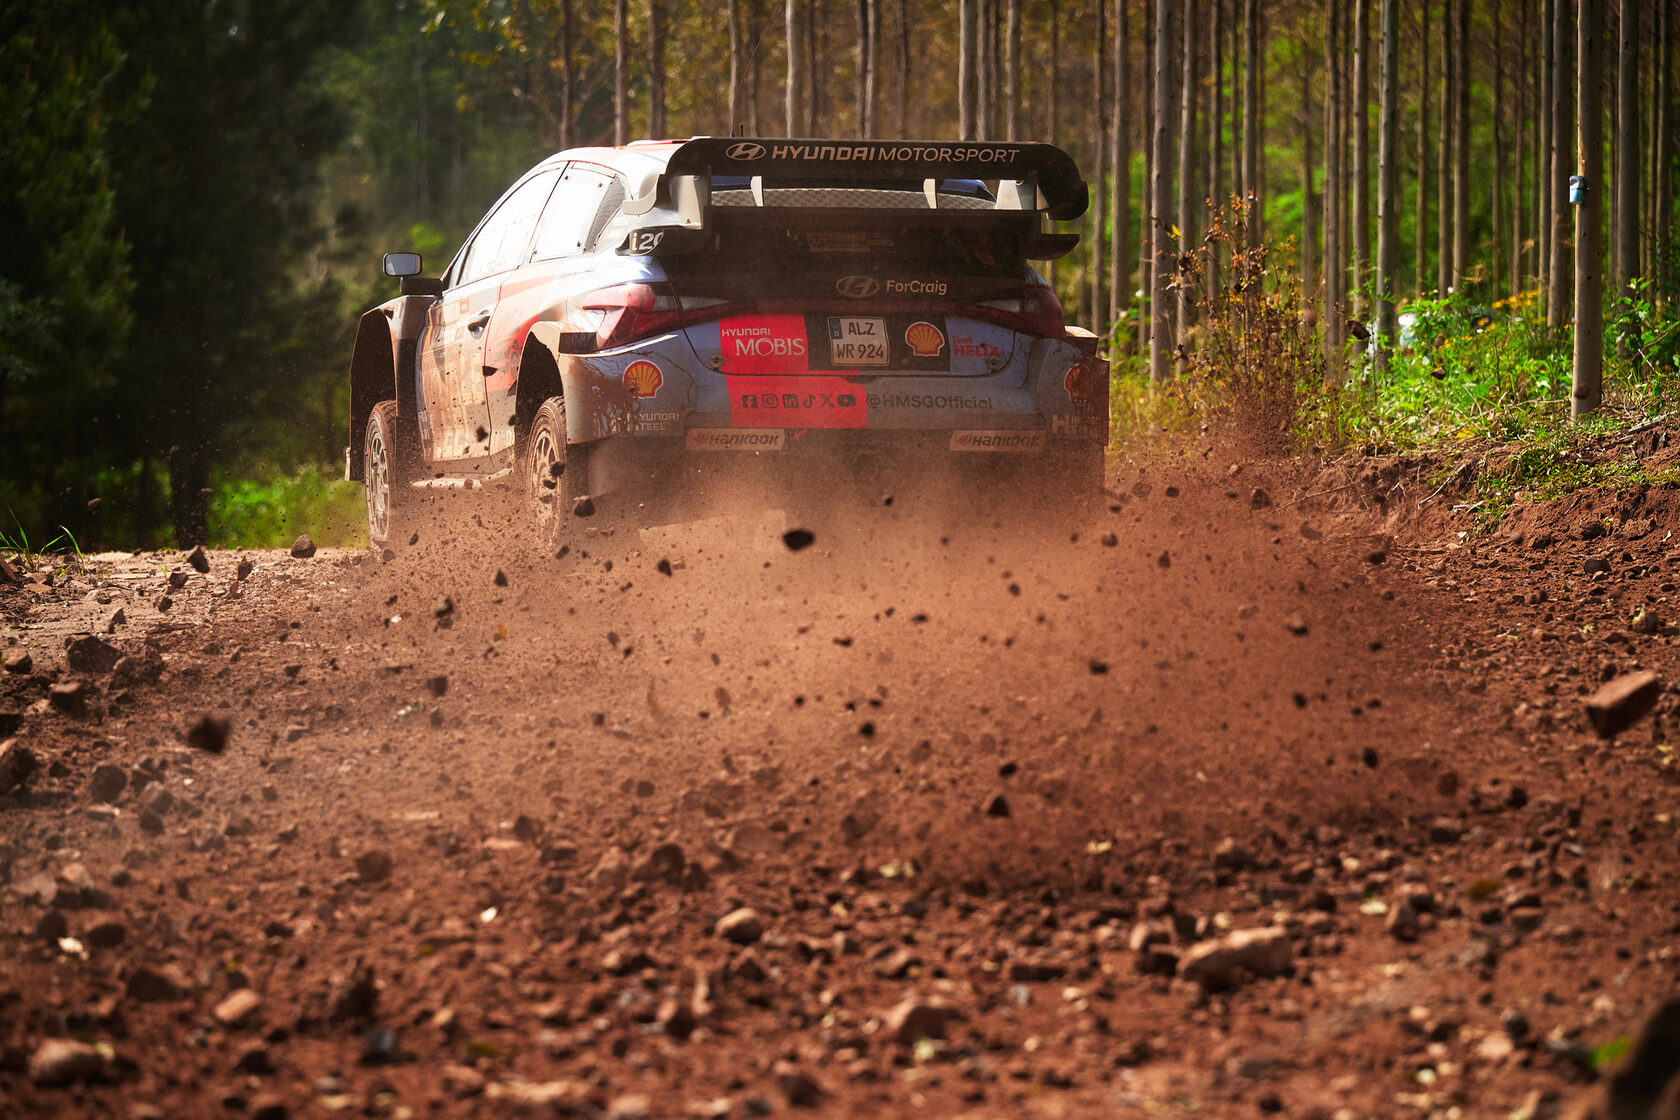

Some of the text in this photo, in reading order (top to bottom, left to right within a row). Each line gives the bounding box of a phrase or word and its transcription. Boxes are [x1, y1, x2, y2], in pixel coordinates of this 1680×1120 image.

[771, 145, 1020, 163] HYUNDAI MOTORSPORT
[886, 279, 948, 296] ForCraig
[721, 328, 771, 336] HYUNDAI
[848, 321, 876, 336] ALZ
[735, 337, 805, 357] MOBIS
[951, 335, 973, 344] Shell
[836, 343, 884, 359] WR 924
[951, 344, 1001, 358] HELIX
[866, 394, 993, 409] @HMSGOfficial
[634, 412, 680, 421] YUNDAI
